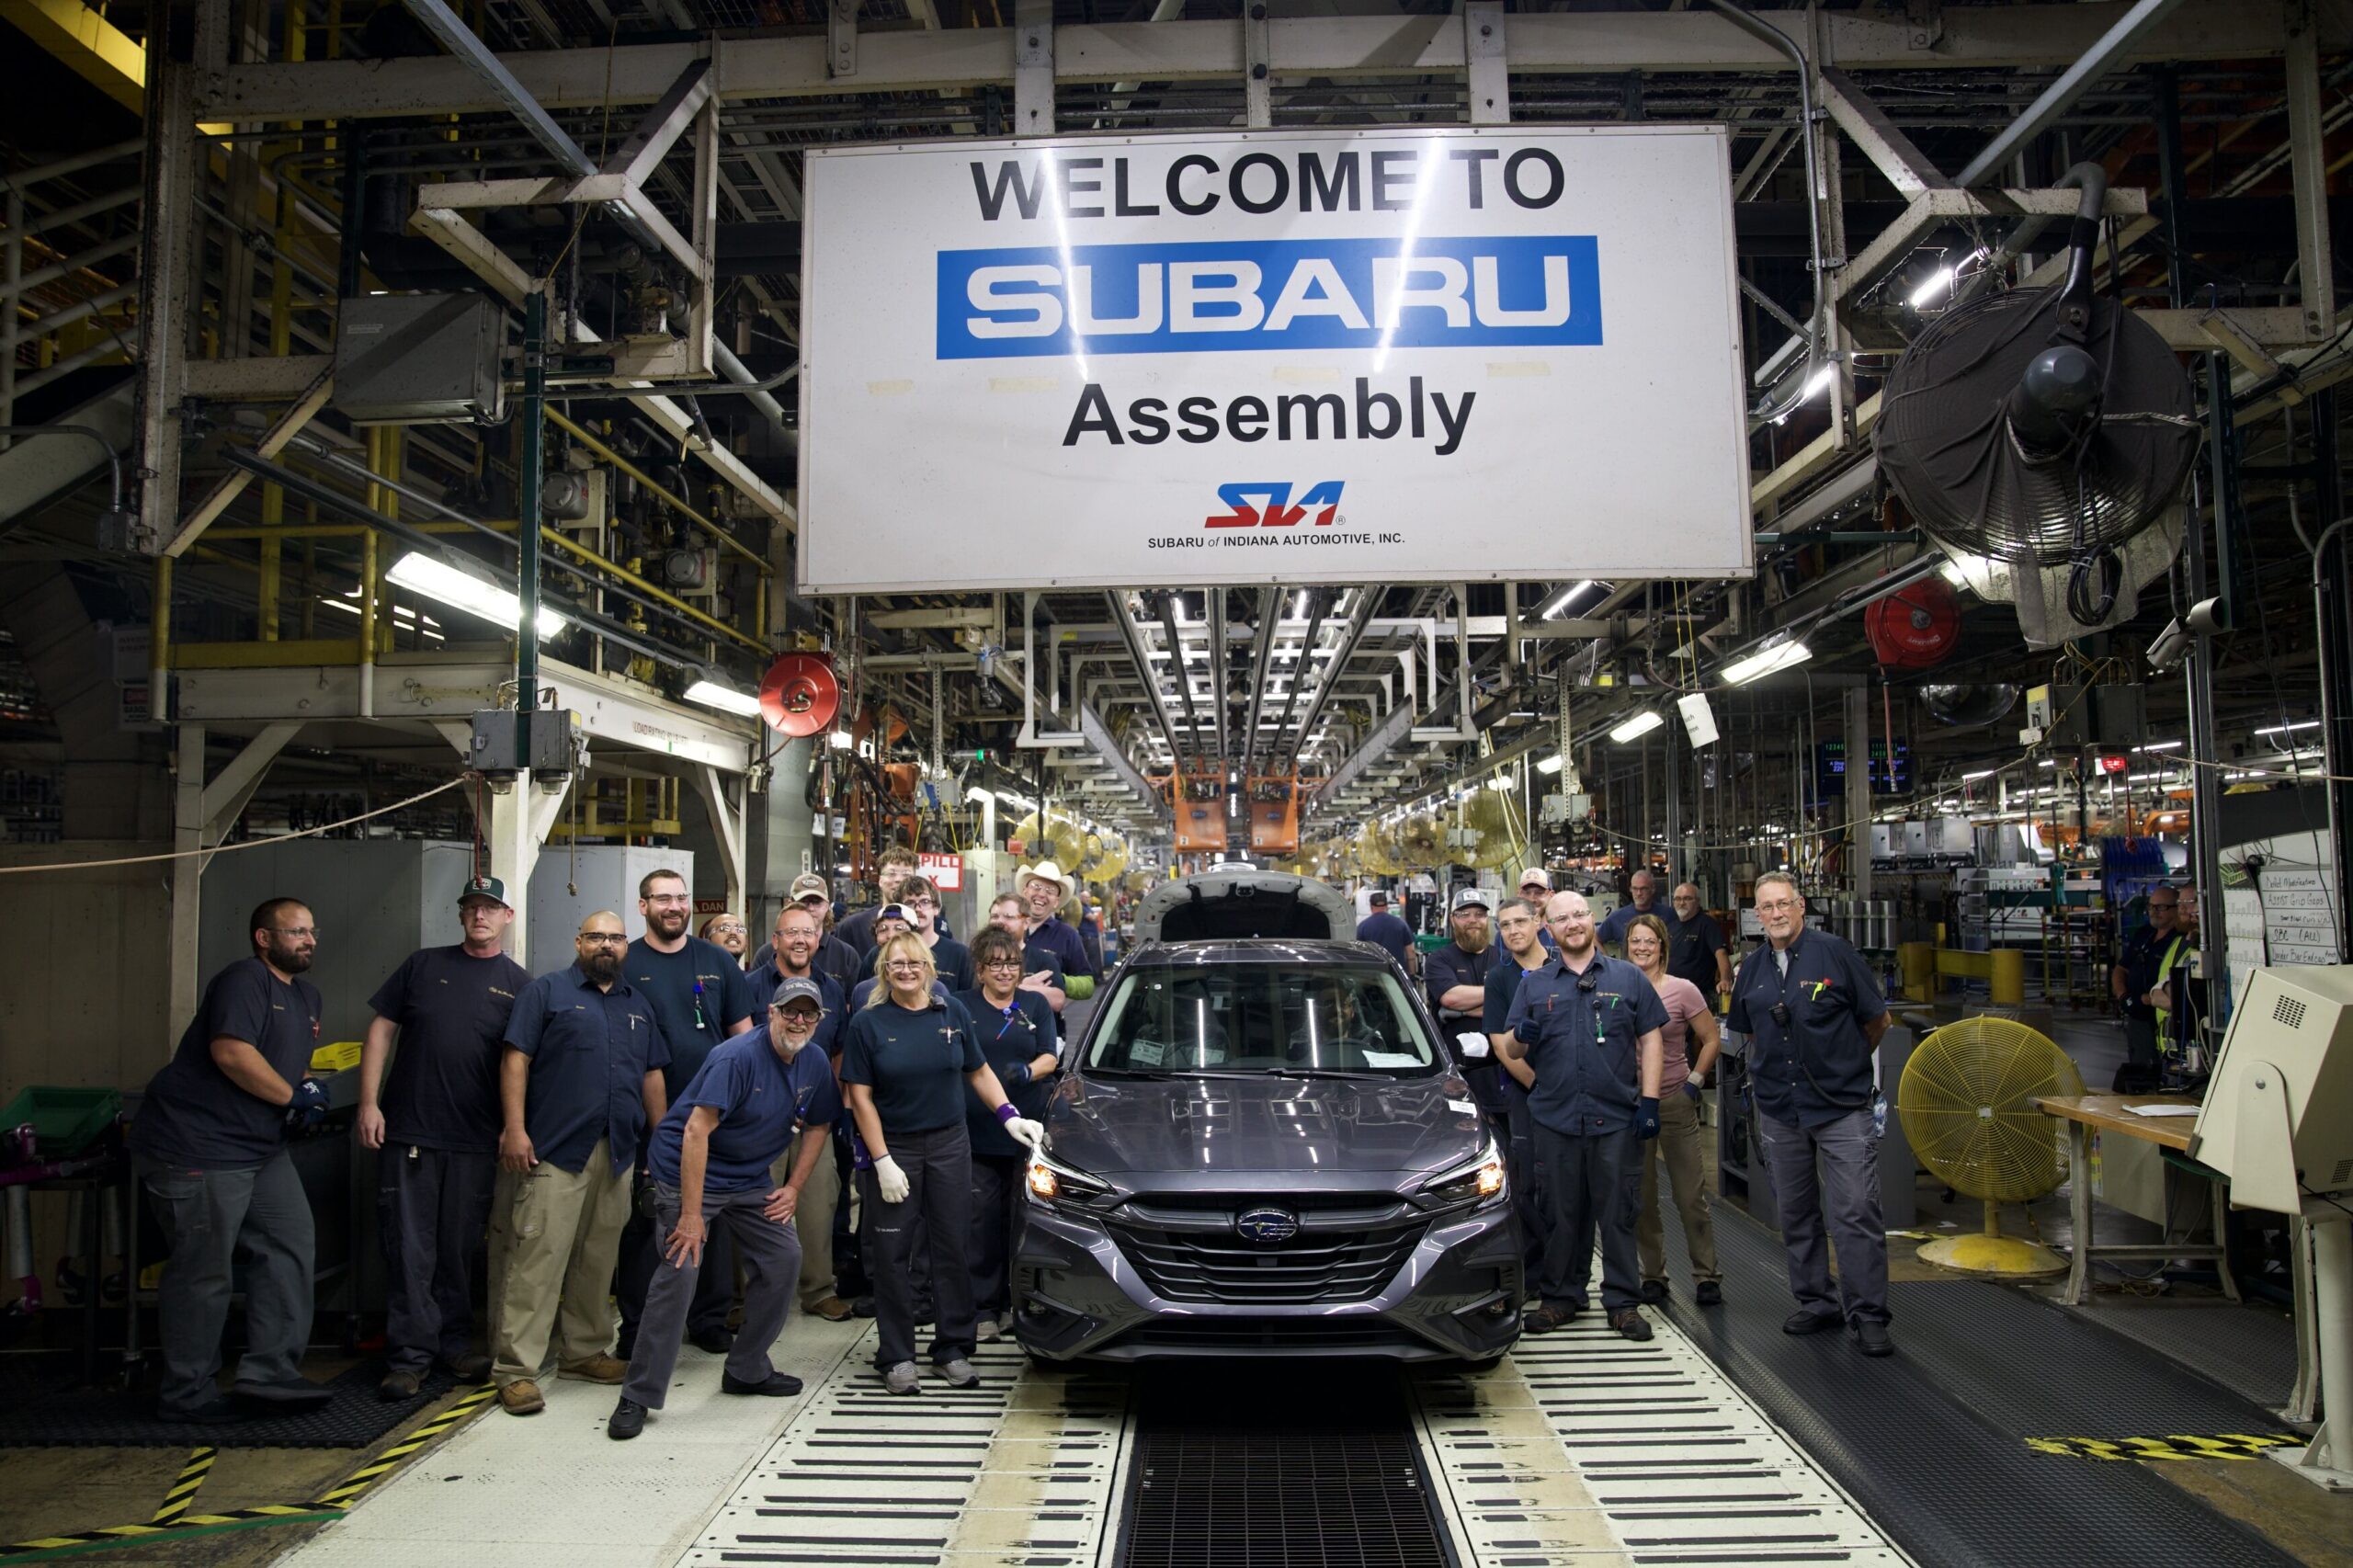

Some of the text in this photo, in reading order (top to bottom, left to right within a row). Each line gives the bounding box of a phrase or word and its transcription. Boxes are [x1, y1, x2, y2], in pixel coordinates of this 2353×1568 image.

[970, 147, 1565, 222] WELCOME TO
[966, 255, 1571, 340] SUBARU
[1063, 377, 1477, 456] Assembly
[1147, 532, 1406, 550] SUBARU of INDIANA AUTOMOTIVE, INC.
[917, 853, 960, 869] PILL
